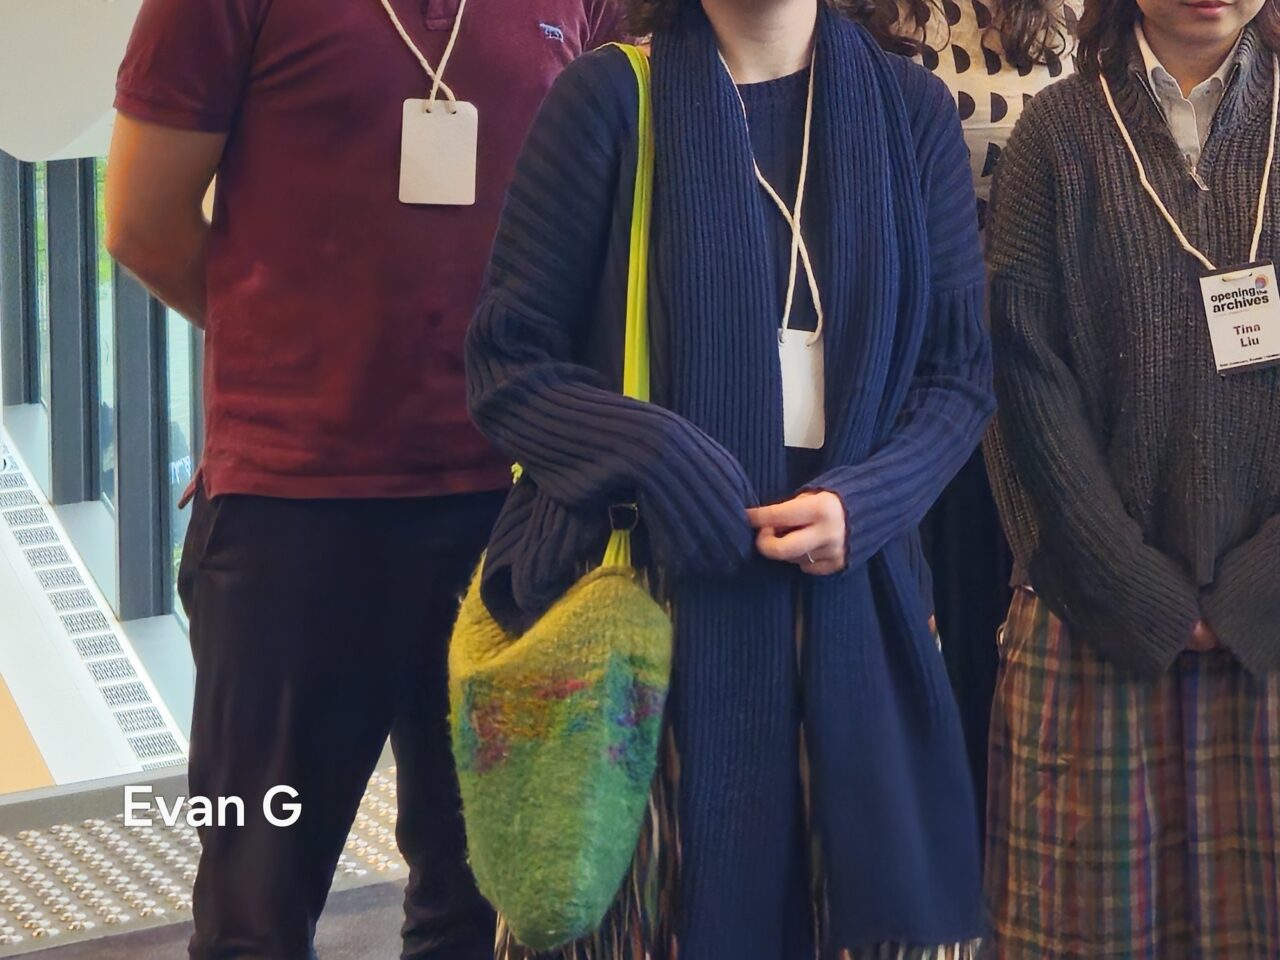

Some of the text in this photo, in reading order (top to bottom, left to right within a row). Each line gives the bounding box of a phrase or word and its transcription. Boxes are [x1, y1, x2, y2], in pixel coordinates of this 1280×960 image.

[1210, 288, 1256, 303] opening
[1213, 295, 1269, 313] archives
[1233, 324, 1261, 335] Tina
[1240, 337, 1260, 348] Liu
